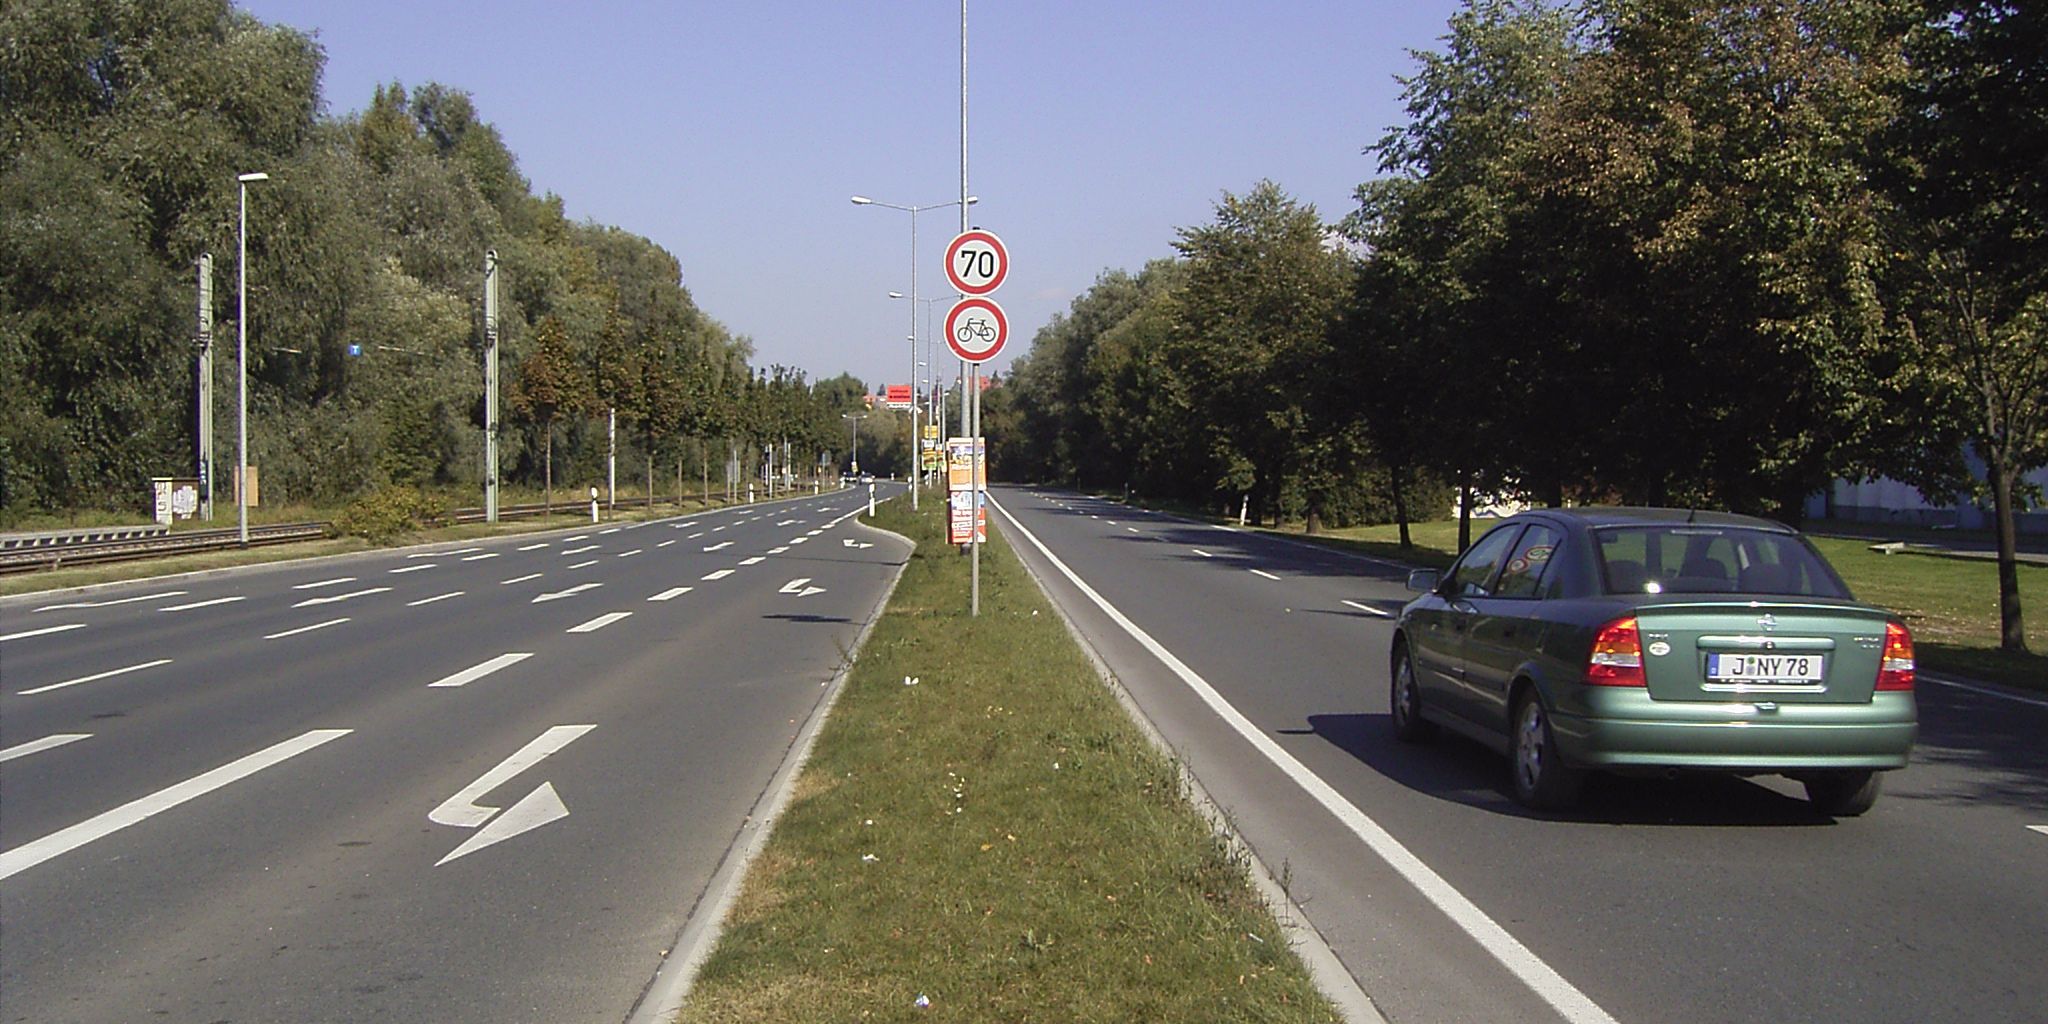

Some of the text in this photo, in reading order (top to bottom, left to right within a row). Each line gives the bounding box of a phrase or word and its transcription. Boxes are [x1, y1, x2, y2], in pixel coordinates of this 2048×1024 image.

[961, 250, 994, 278] 70
[1732, 657, 1809, 676] J NY 78
